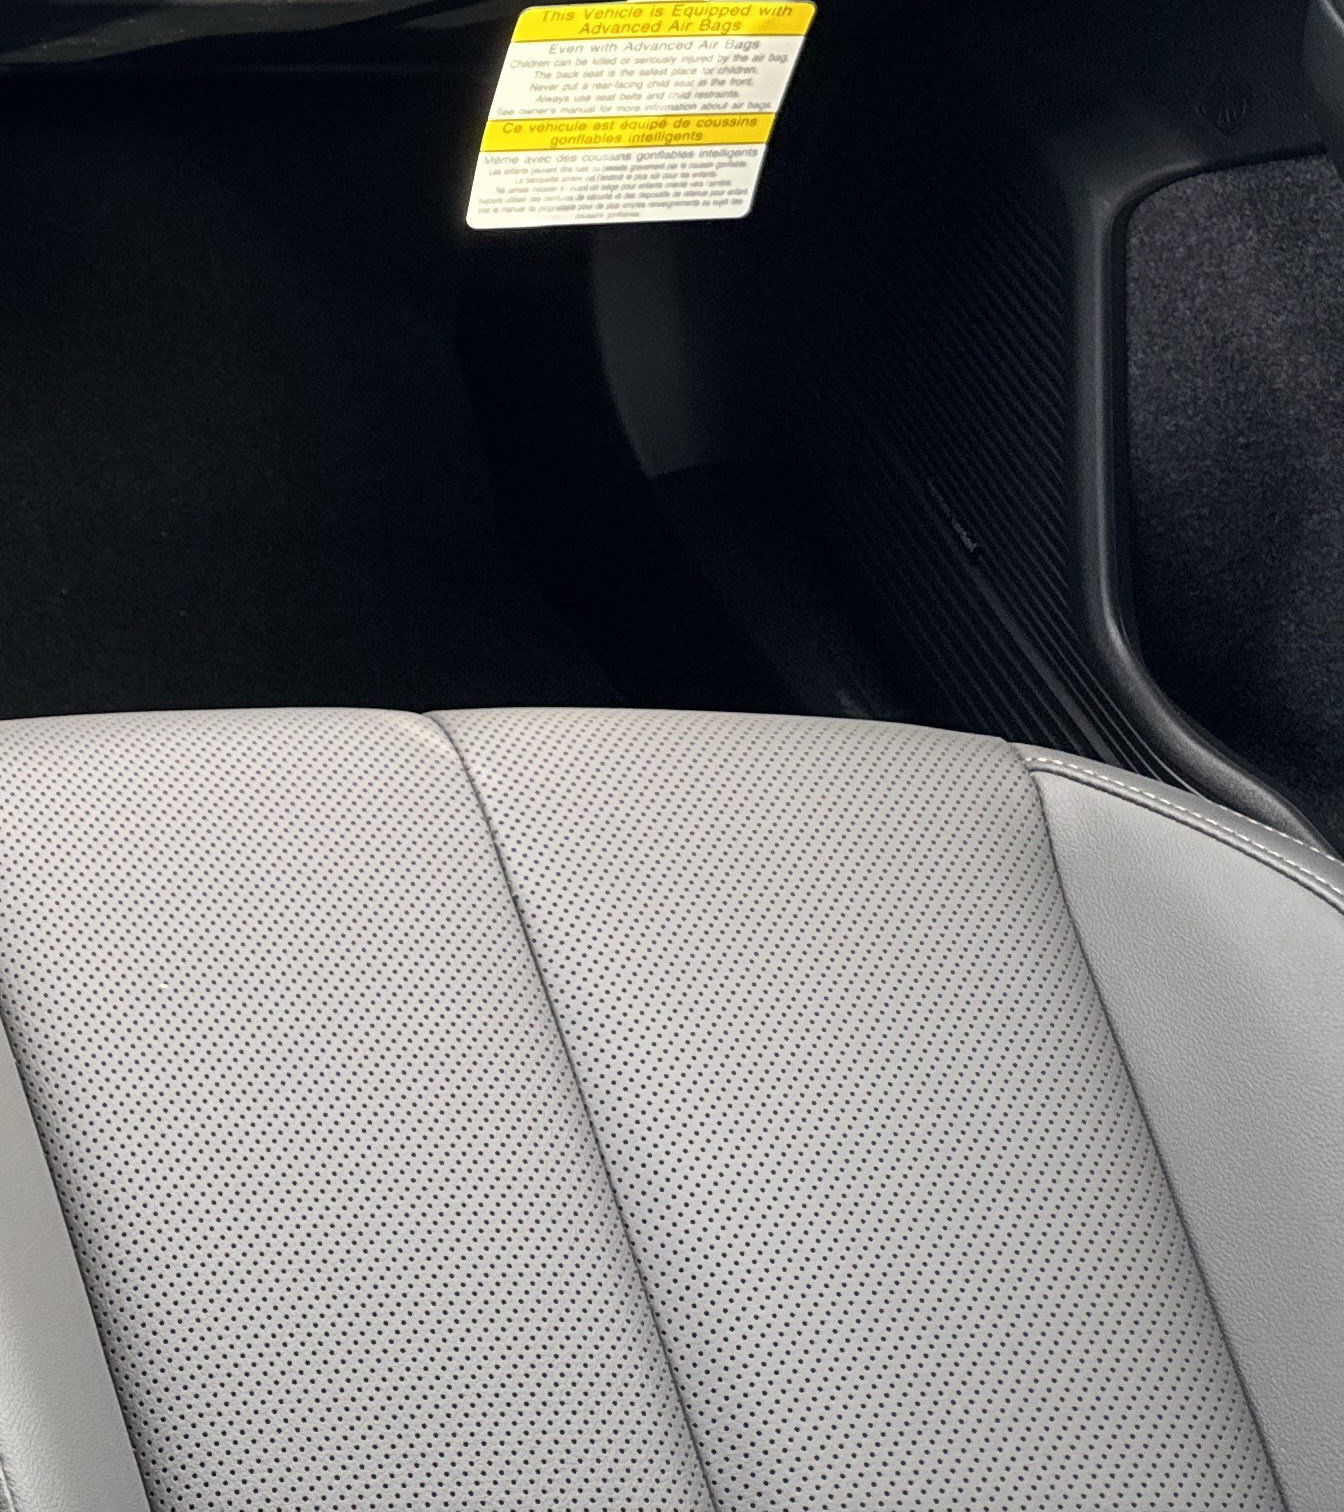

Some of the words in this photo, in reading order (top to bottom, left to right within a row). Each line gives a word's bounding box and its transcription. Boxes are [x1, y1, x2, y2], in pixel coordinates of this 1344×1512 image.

[542, 11, 574, 22] This
[584, 8, 642, 20] Vehicle
[650, 6, 663, 18] is
[672, 4, 752, 20] Equipped
[759, 6, 793, 17] with
[578, 22, 661, 35] Advanced
[668, 20, 692, 33] Air
[699, 19, 742, 35] Bags
[548, 44, 585, 54] Even
[590, 42, 618, 53] with
[623, 41, 693, 52] Advanced
[698, 40, 719, 50] Air
[724, 39, 760, 51] Bags
[502, 122, 522, 134] Ce
[529, 120, 587, 133] véhicule
[593, 120, 615, 132] est
[673, 118, 691, 128] de
[696, 117, 758, 128] coussins
[550, 134, 623, 148] gonflables
[628, 131, 703, 145] intelligents
